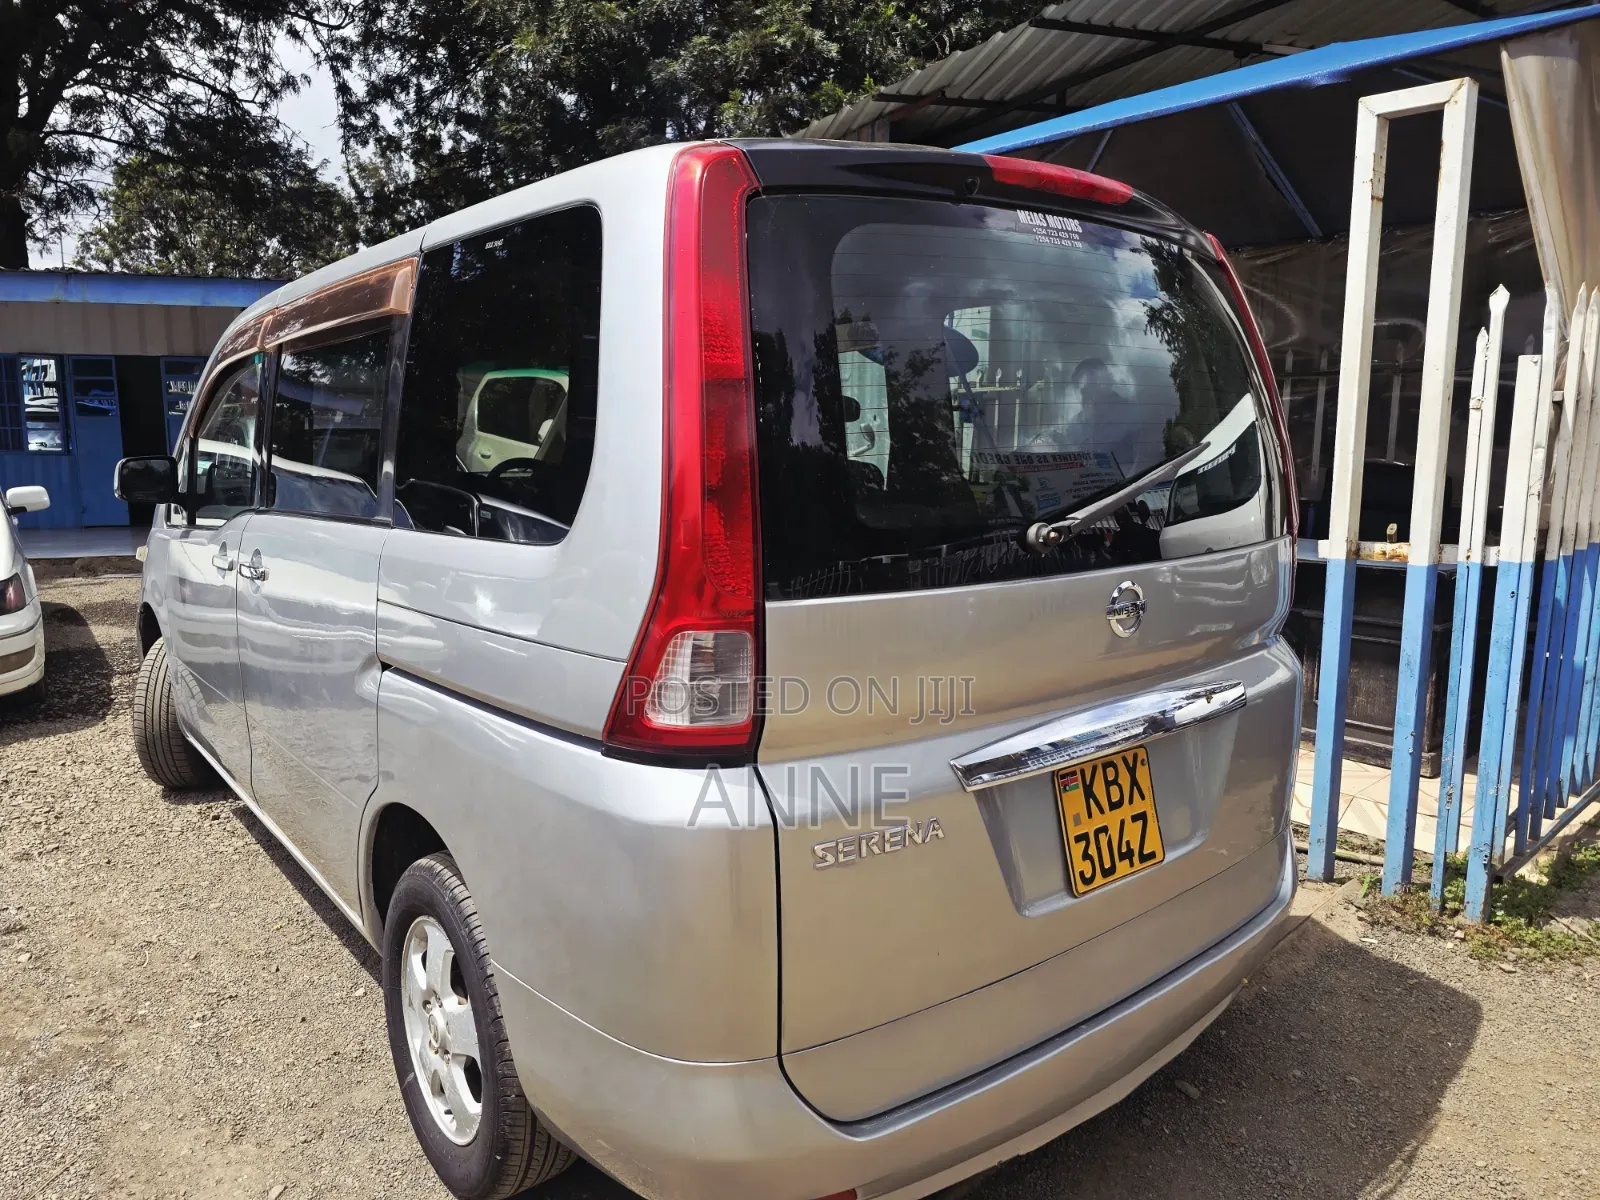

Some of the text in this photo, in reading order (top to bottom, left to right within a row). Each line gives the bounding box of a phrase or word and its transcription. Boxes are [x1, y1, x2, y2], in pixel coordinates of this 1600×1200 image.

[1045, 214, 1082, 233] MOTORS
[1079, 752, 1146, 819] KBX
[812, 817, 946, 869] SERENA
[1074, 810, 1157, 886] 304Z
